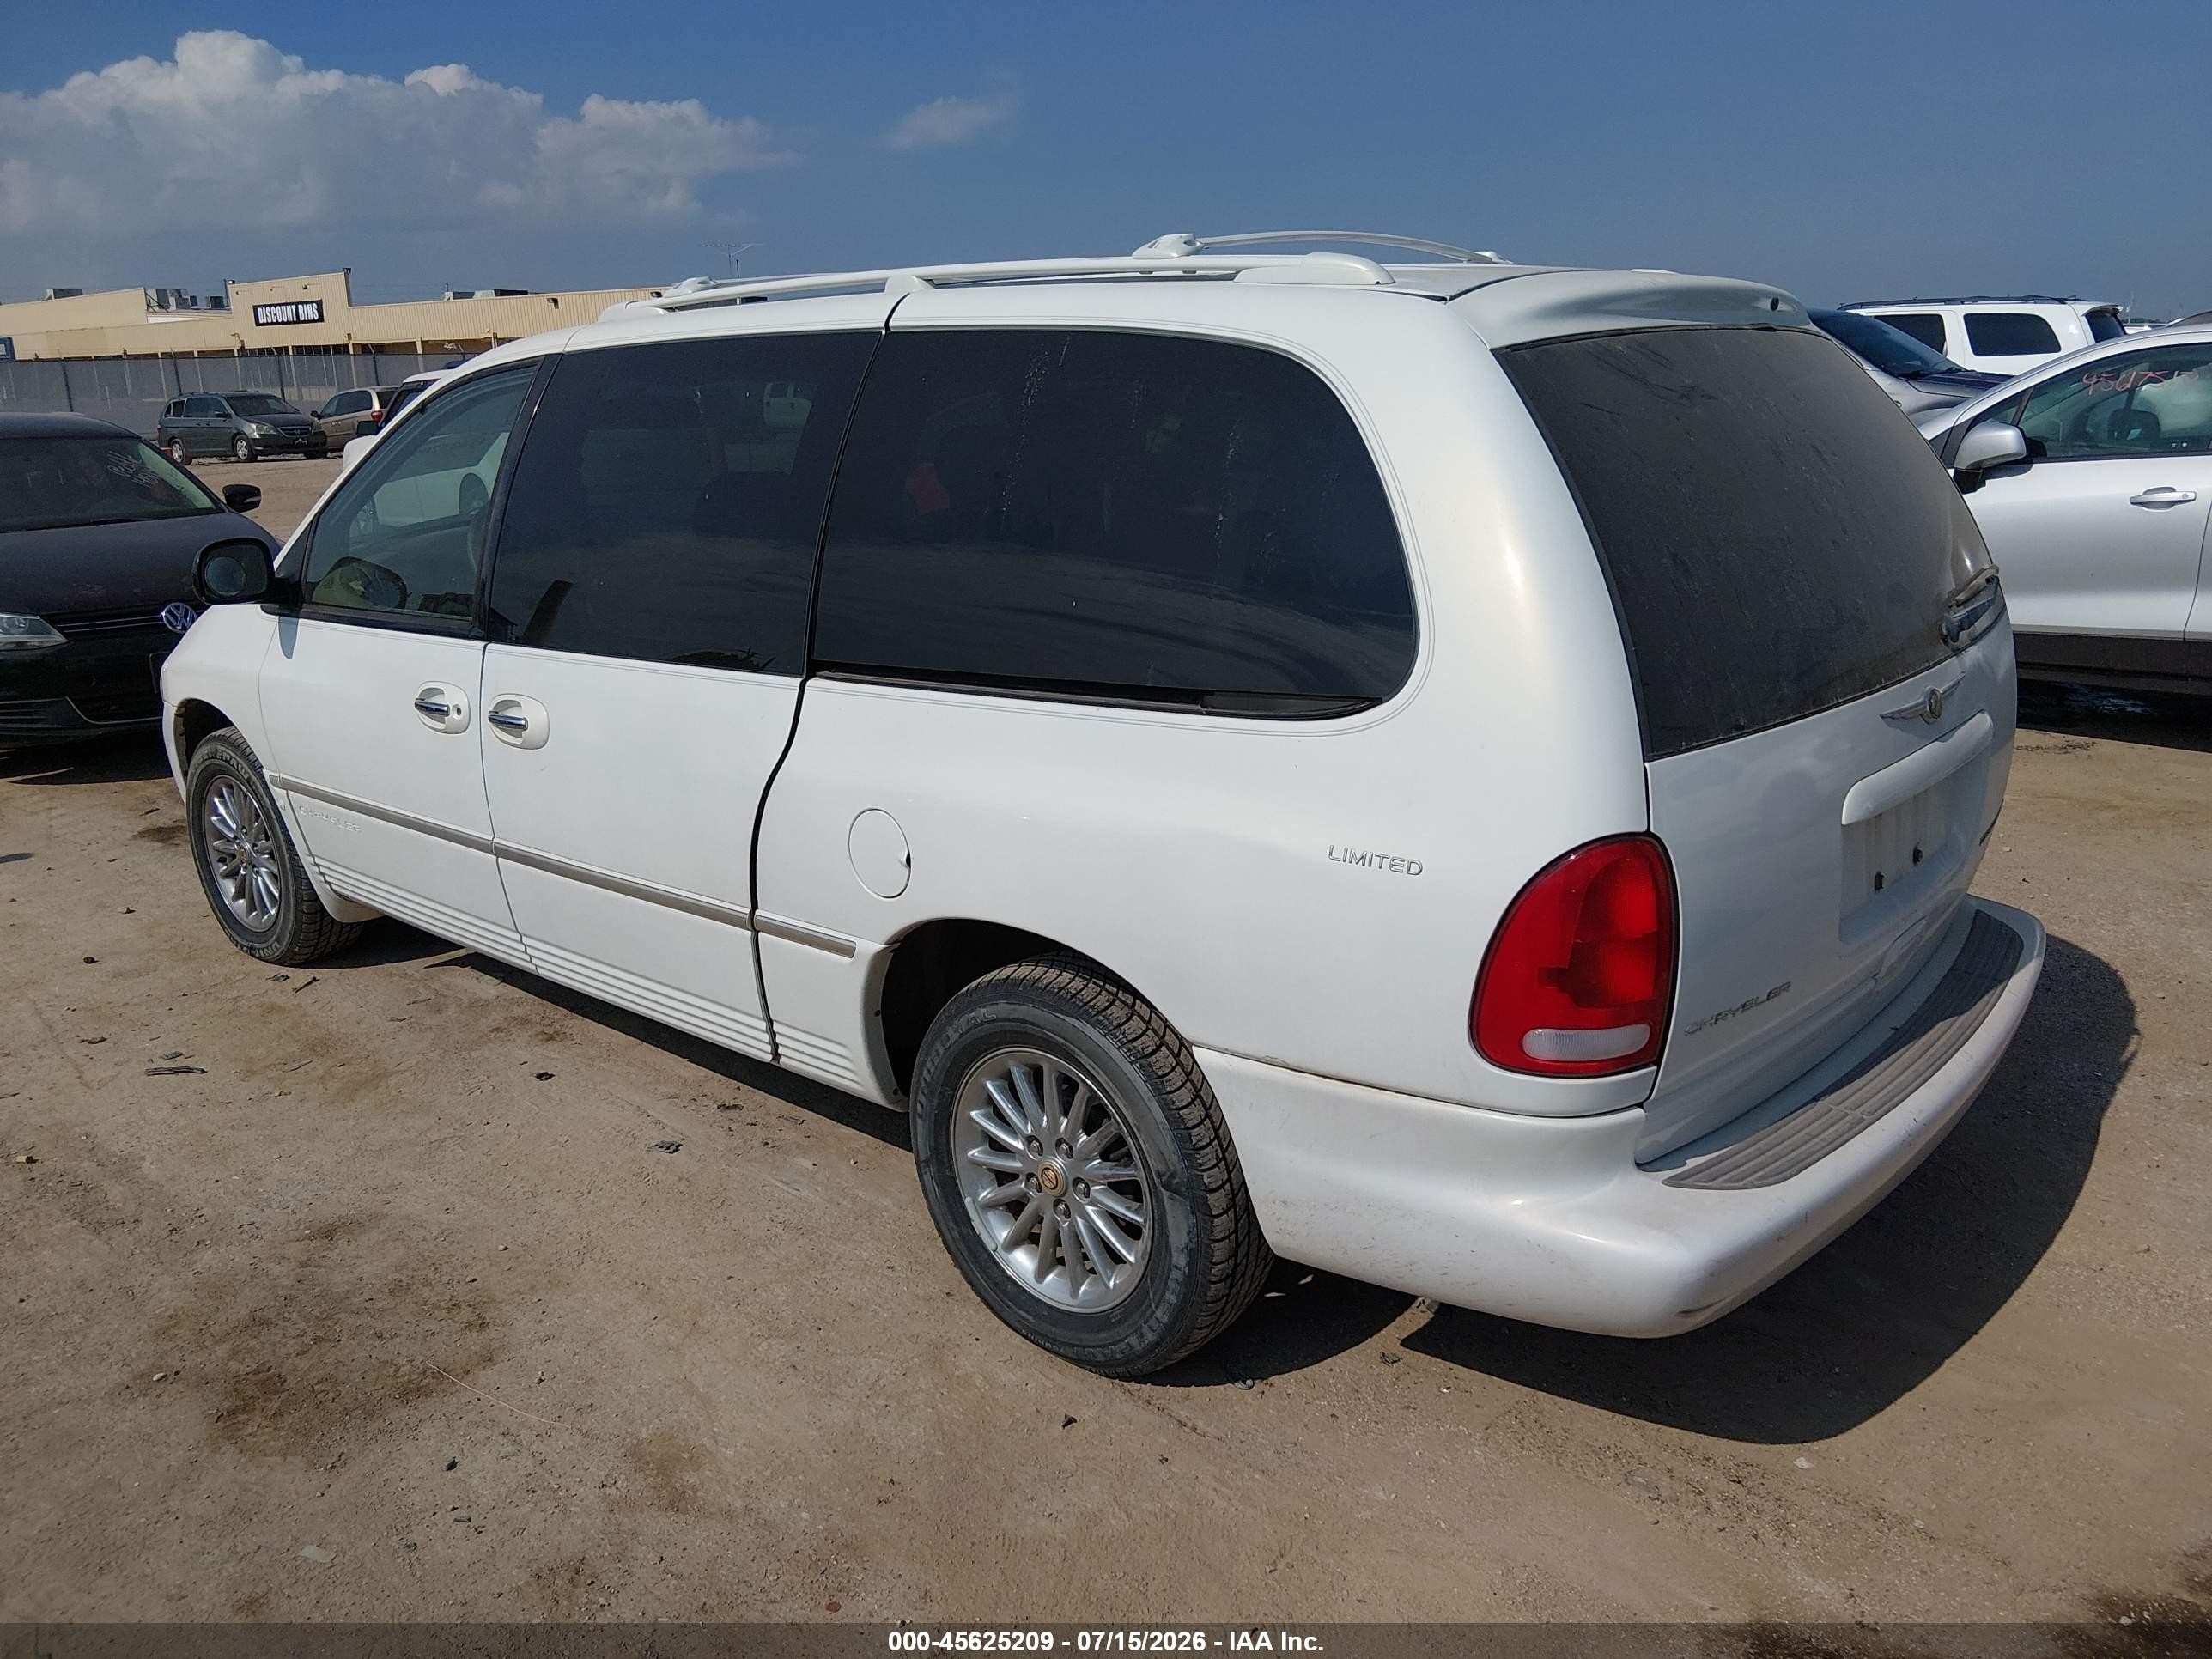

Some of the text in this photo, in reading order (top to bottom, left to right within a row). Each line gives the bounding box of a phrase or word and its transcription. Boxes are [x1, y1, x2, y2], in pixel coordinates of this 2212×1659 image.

[257, 302, 319, 324] DISCOUNT BINS
[1328, 845, 1424, 876] LIMITED
[1684, 981, 1791, 1036] CHRYSLER
